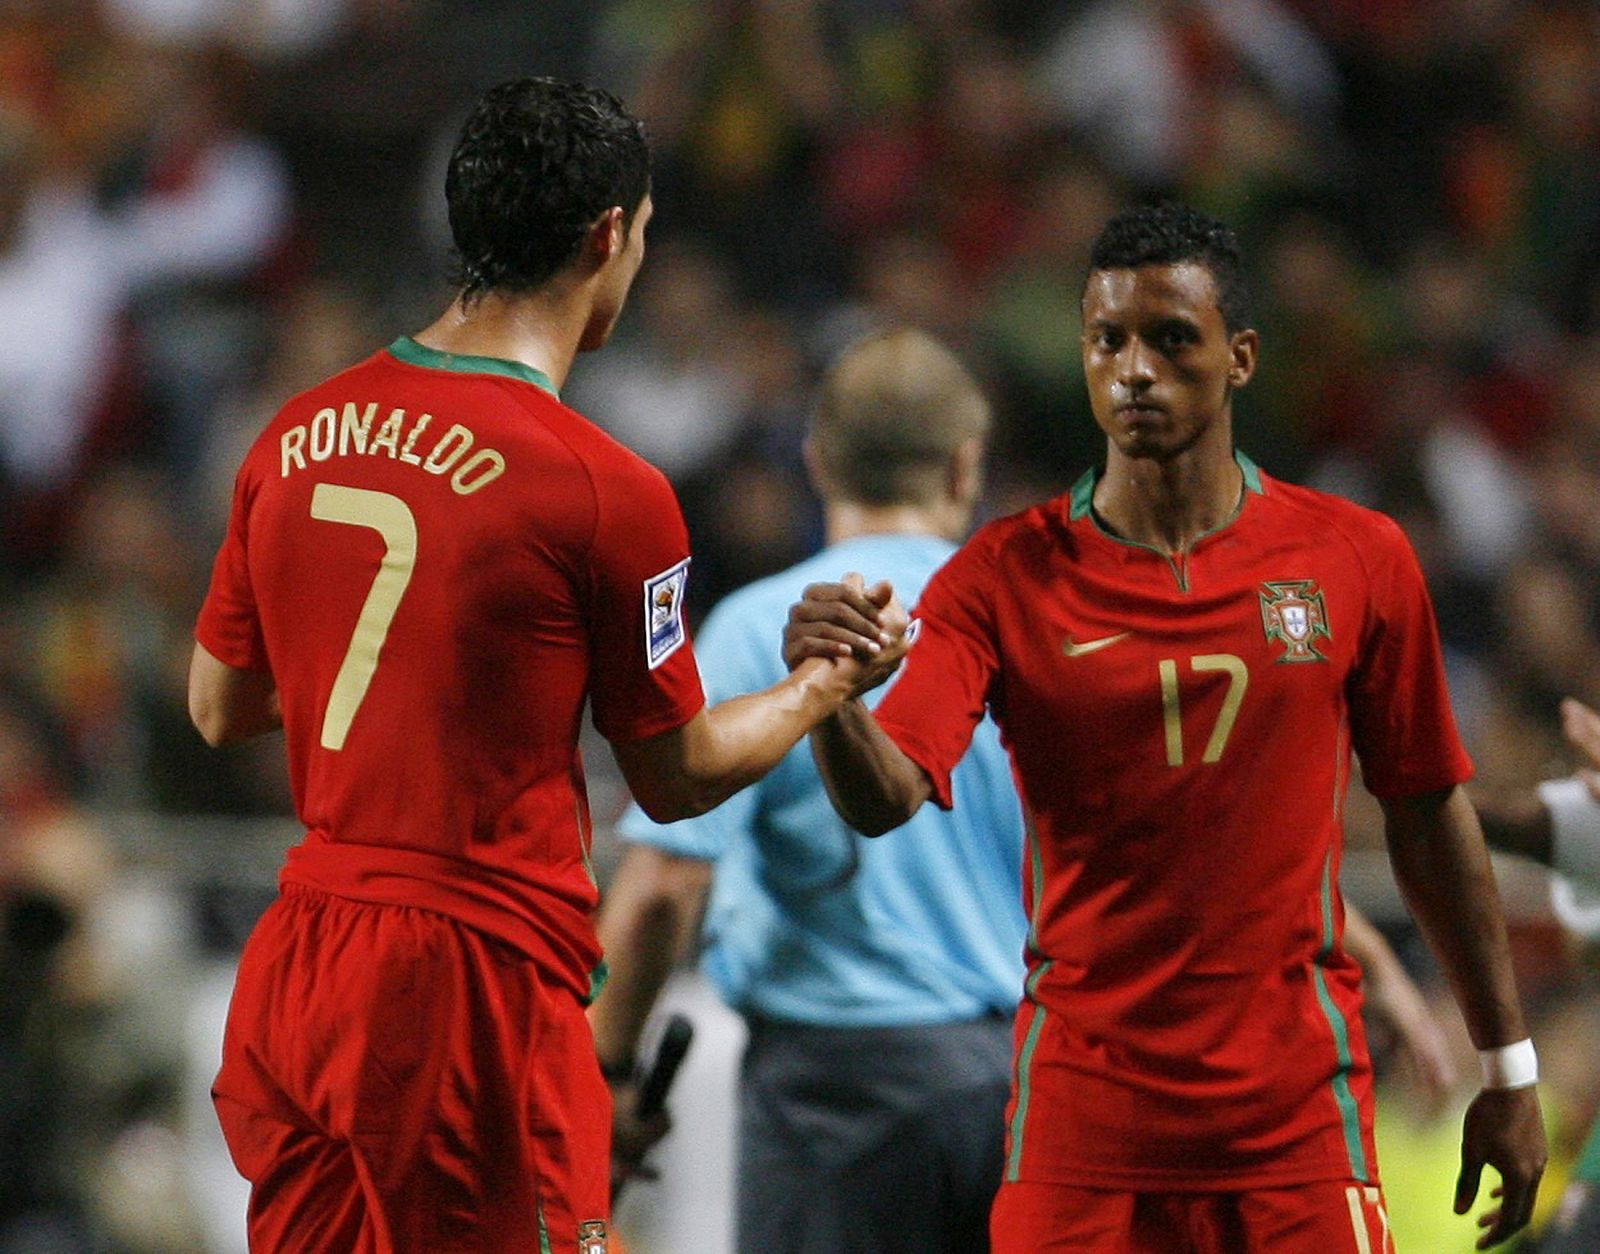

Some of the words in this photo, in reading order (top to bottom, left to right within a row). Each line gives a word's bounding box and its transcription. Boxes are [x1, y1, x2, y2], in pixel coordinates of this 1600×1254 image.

[281, 402, 505, 495] RONALDO
[310, 483, 418, 751] 7
[1159, 654, 1248, 767] 17
